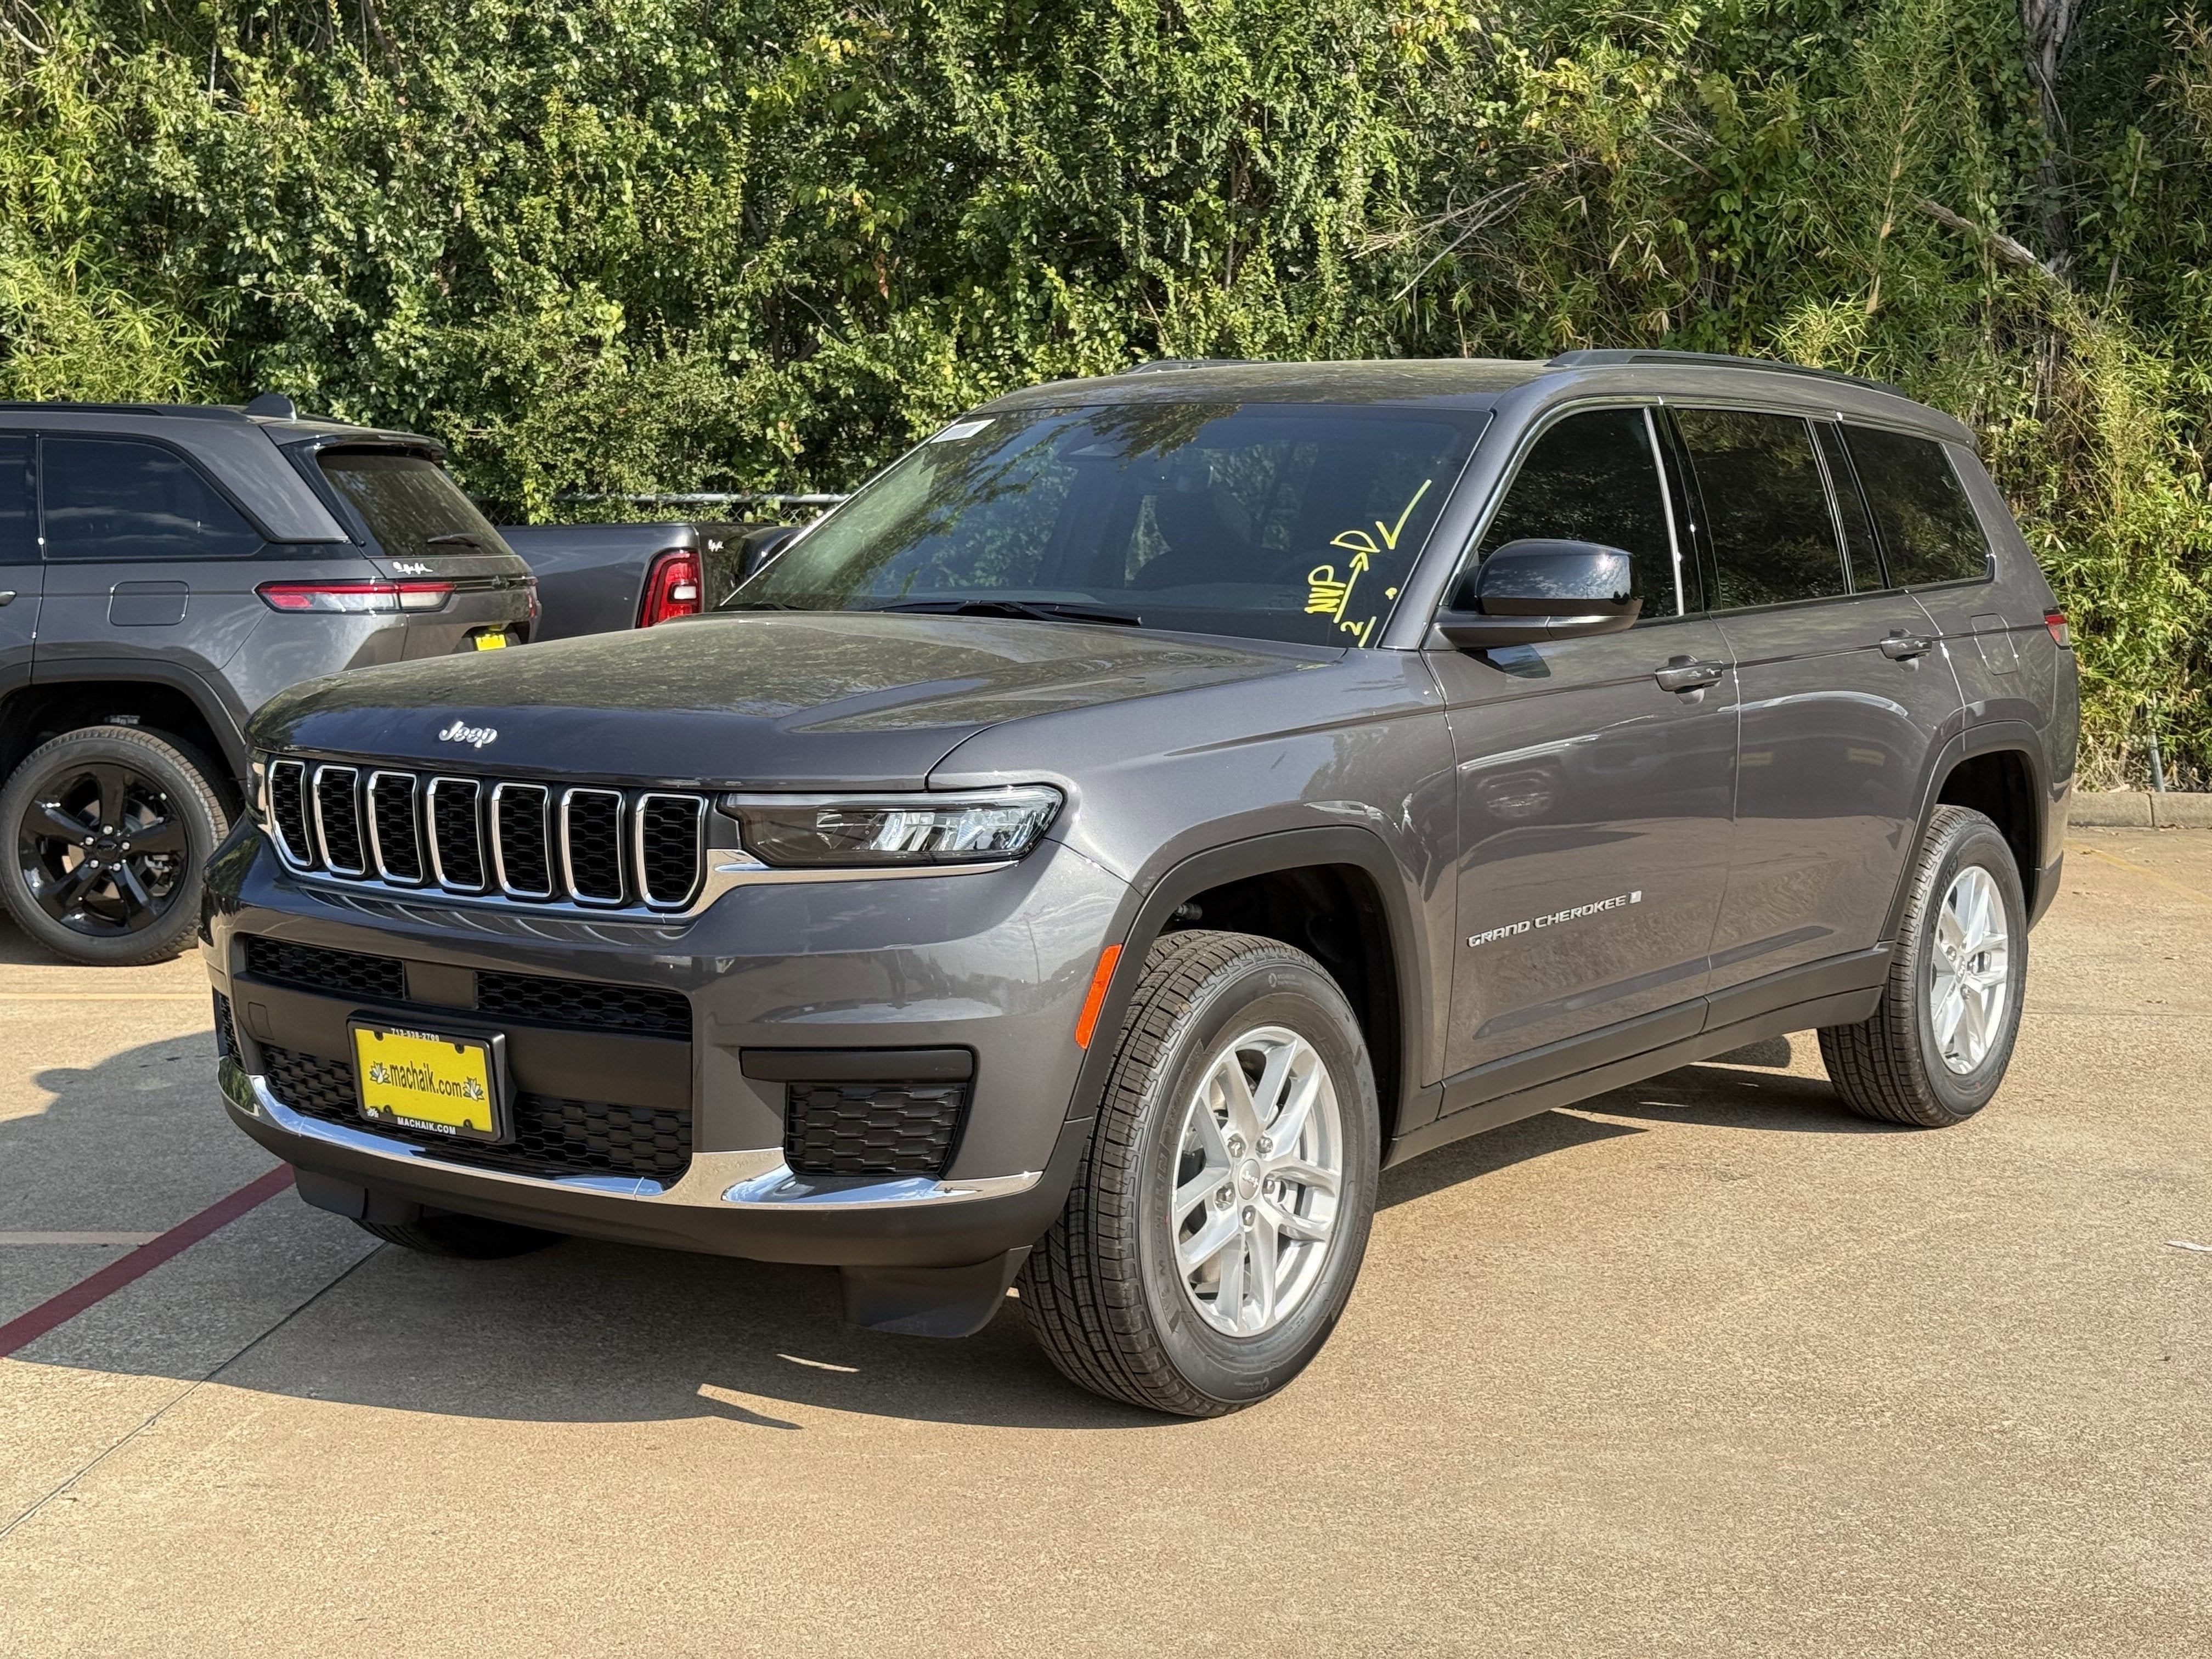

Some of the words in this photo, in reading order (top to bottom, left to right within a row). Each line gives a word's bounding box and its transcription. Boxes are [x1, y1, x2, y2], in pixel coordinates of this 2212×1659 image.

[439, 721, 497, 748] Jeep
[1468, 920, 1530, 947] GRAND
[1534, 894, 1627, 929] CHEROKEE
[390, 1060, 462, 1098] machaik.com
[397, 1116, 456, 1135] MACHAIK.COM
